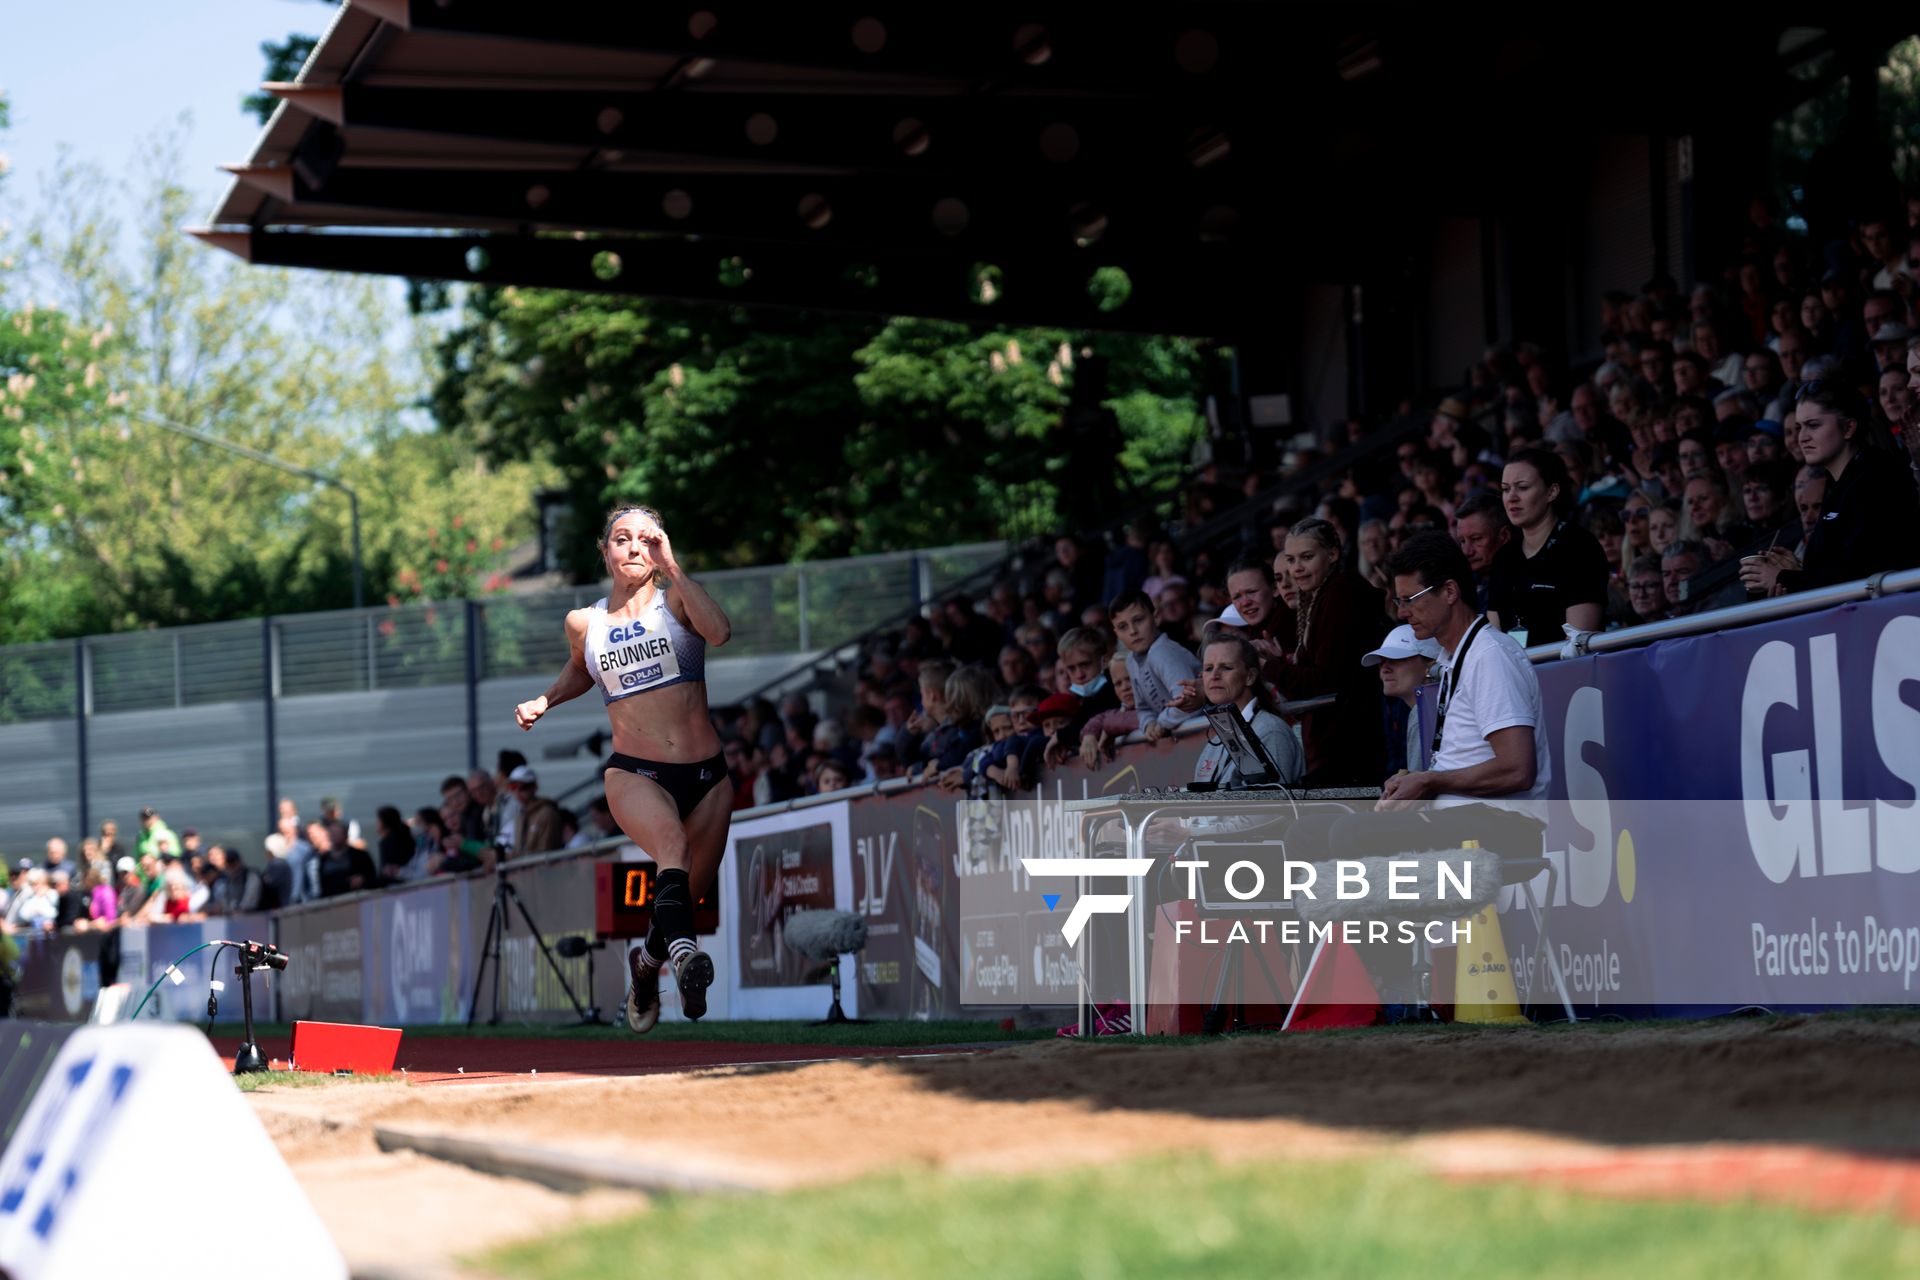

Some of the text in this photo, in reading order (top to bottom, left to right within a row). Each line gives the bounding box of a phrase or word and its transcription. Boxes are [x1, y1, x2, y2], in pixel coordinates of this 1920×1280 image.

[599, 637, 671, 672] BRUNNER
[636, 666, 661, 680] PLAN
[999, 794, 1034, 893] App
[1481, 963, 1506, 973] JAKO
[1560, 938, 1621, 1008] People
[1751, 915, 1920, 991] Parcels to Peop
